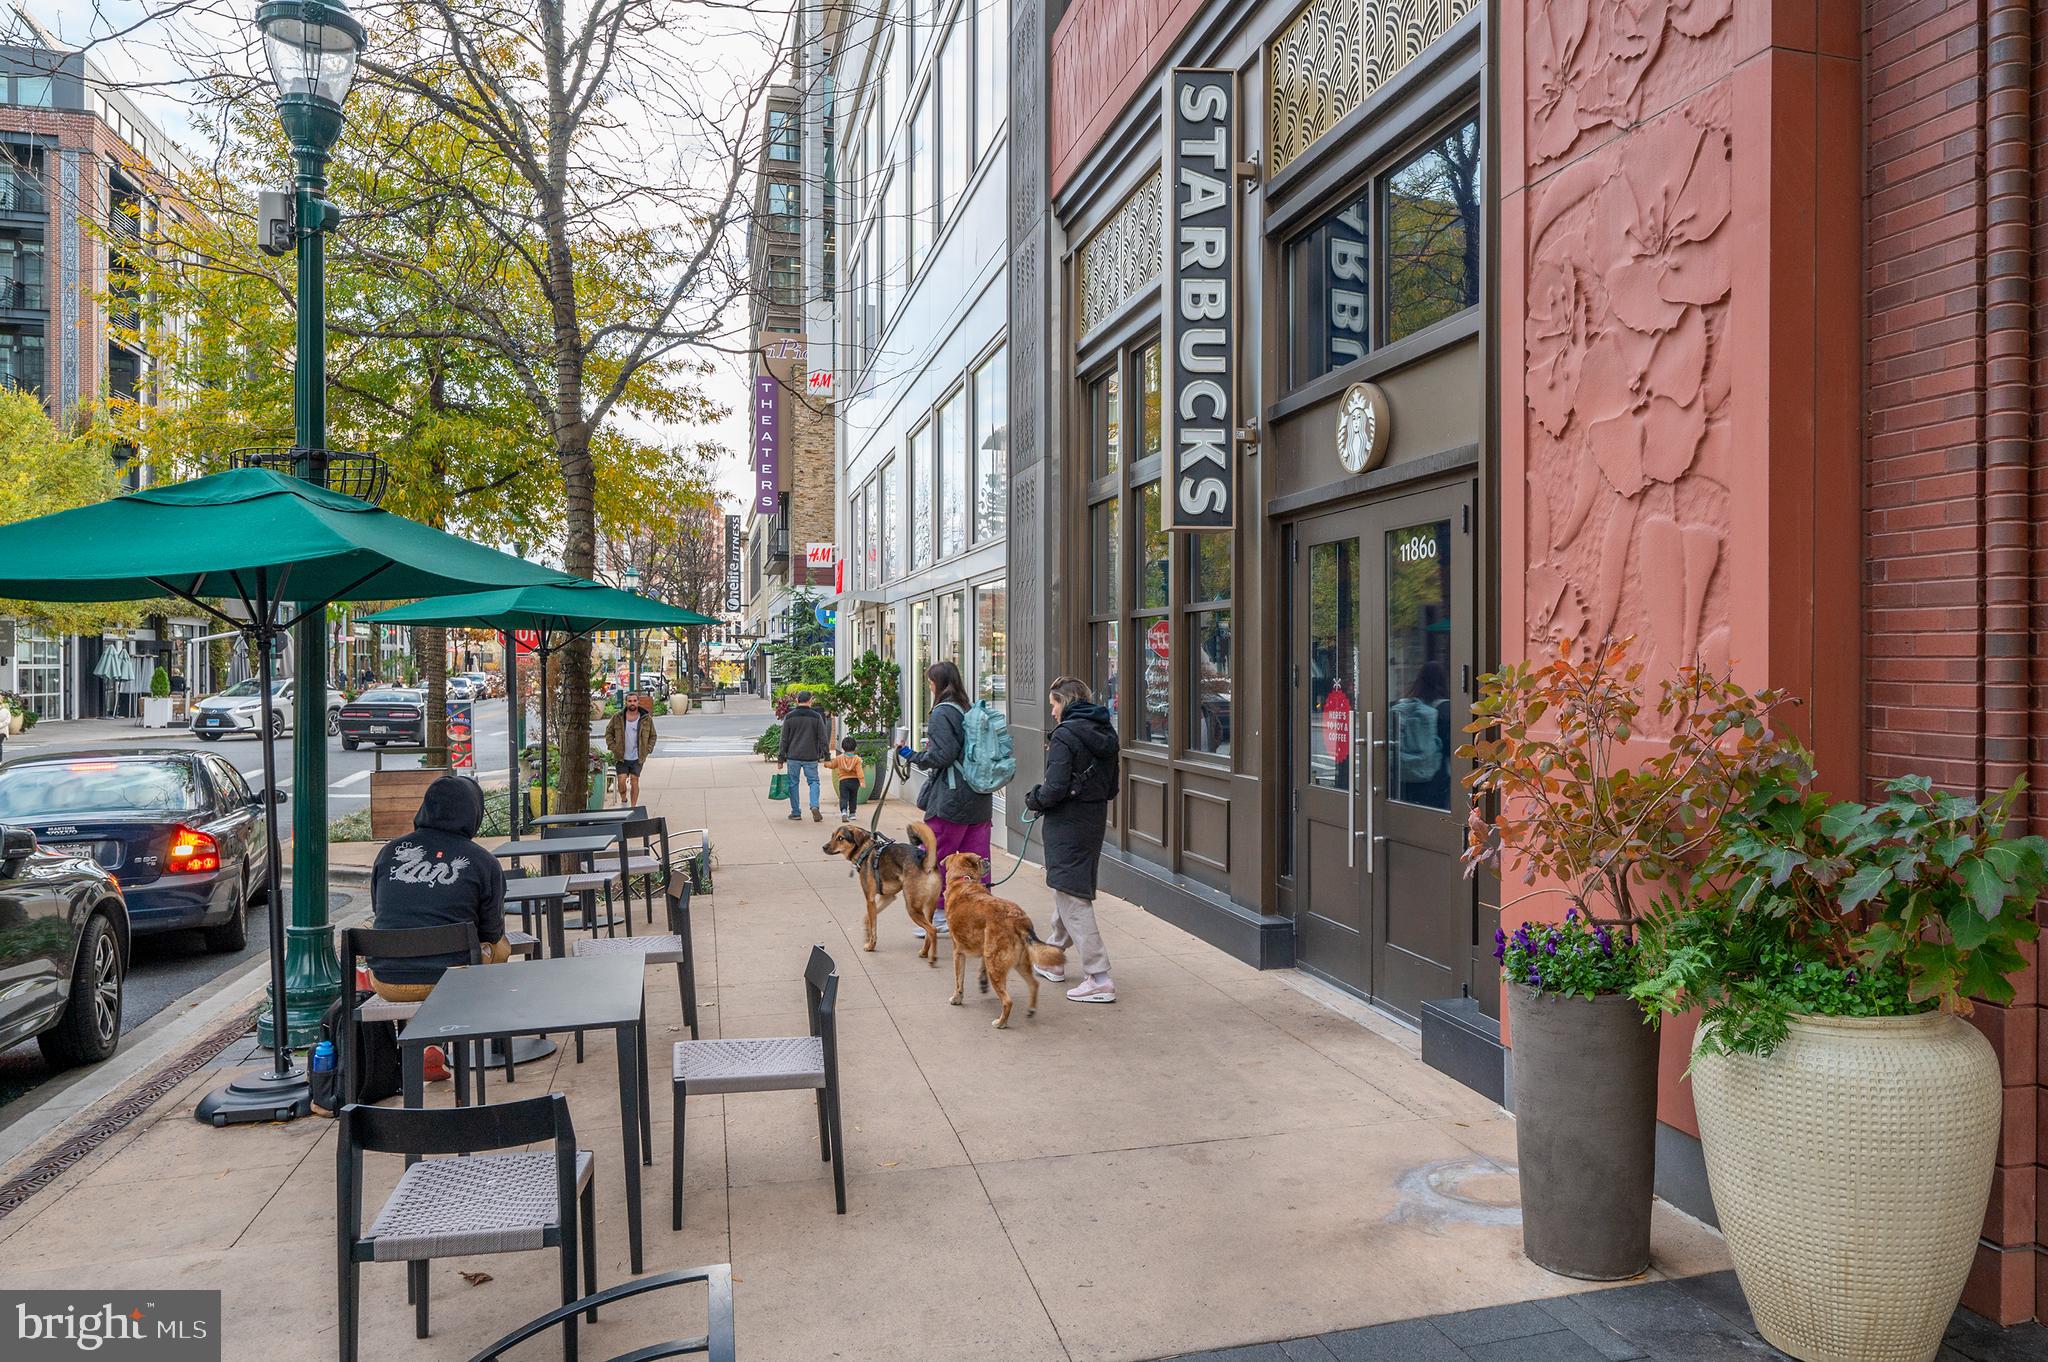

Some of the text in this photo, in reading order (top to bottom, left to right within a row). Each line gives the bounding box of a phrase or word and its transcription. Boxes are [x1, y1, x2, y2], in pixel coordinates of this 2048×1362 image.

[1179, 83, 1228, 516] STARBUCKS
[761, 383, 773, 507] THEATERS
[732, 516, 740, 562] FITNESS
[1400, 535, 1436, 562] 11860
[808, 547, 832, 563] H&M
[1329, 710, 1347, 720] HERE'S
[1328, 732, 1347, 742] COFFEE
